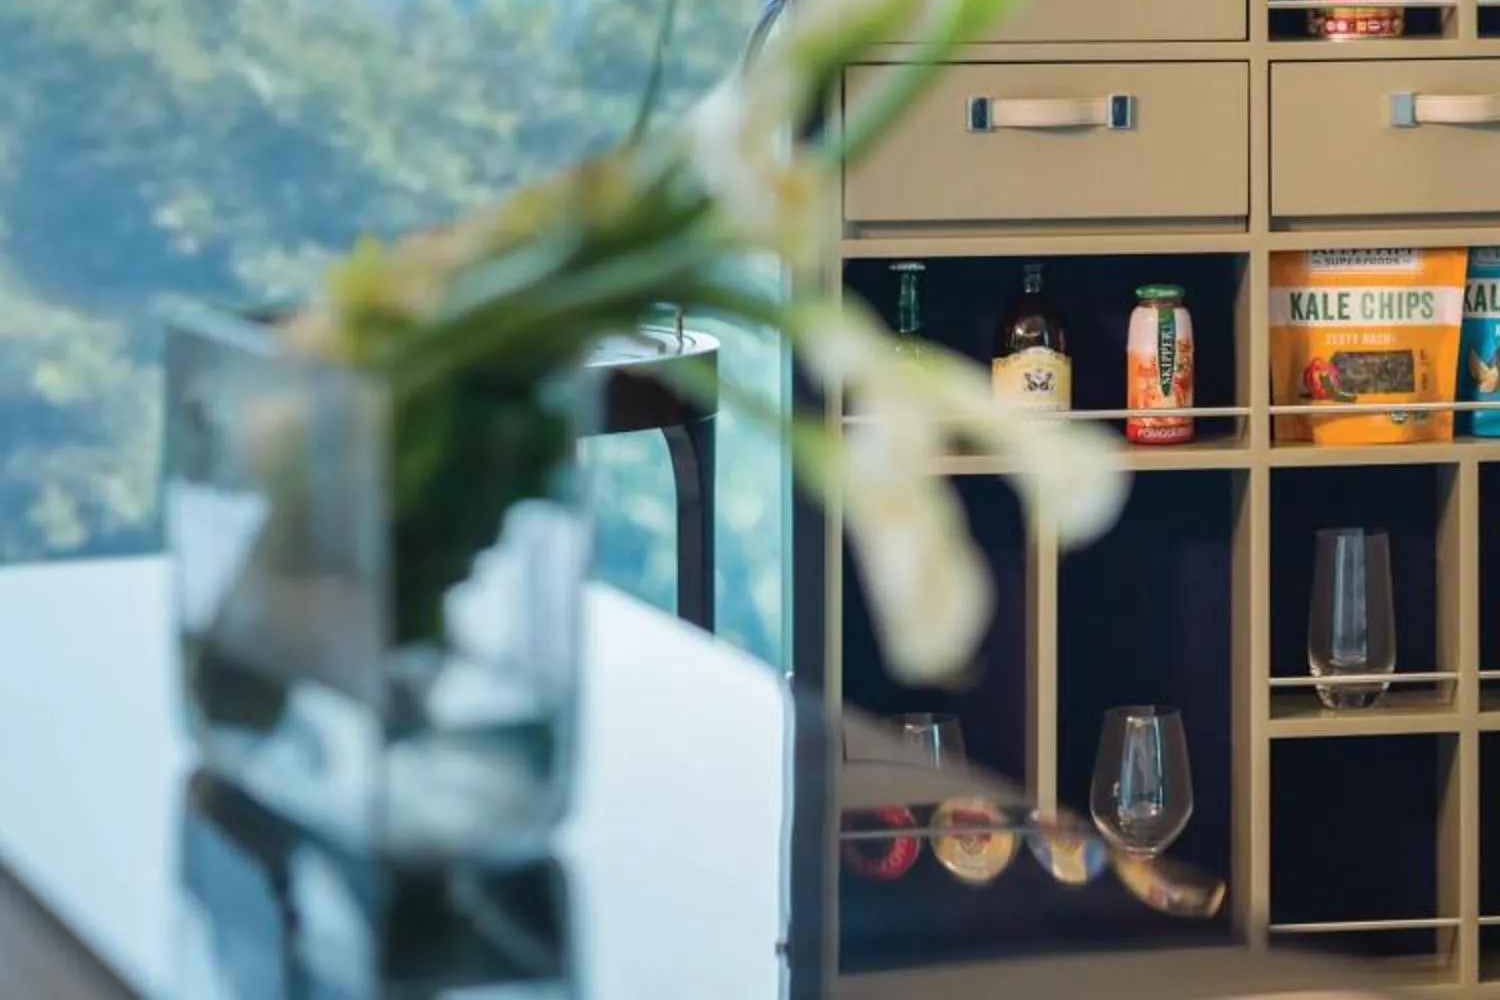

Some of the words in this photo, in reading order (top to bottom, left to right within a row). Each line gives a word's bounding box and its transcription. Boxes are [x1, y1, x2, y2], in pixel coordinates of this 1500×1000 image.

[1290, 292, 1351, 320] KALE
[1361, 290, 1435, 320] CHIPS
[1160, 330, 1174, 384] SKIPPER
